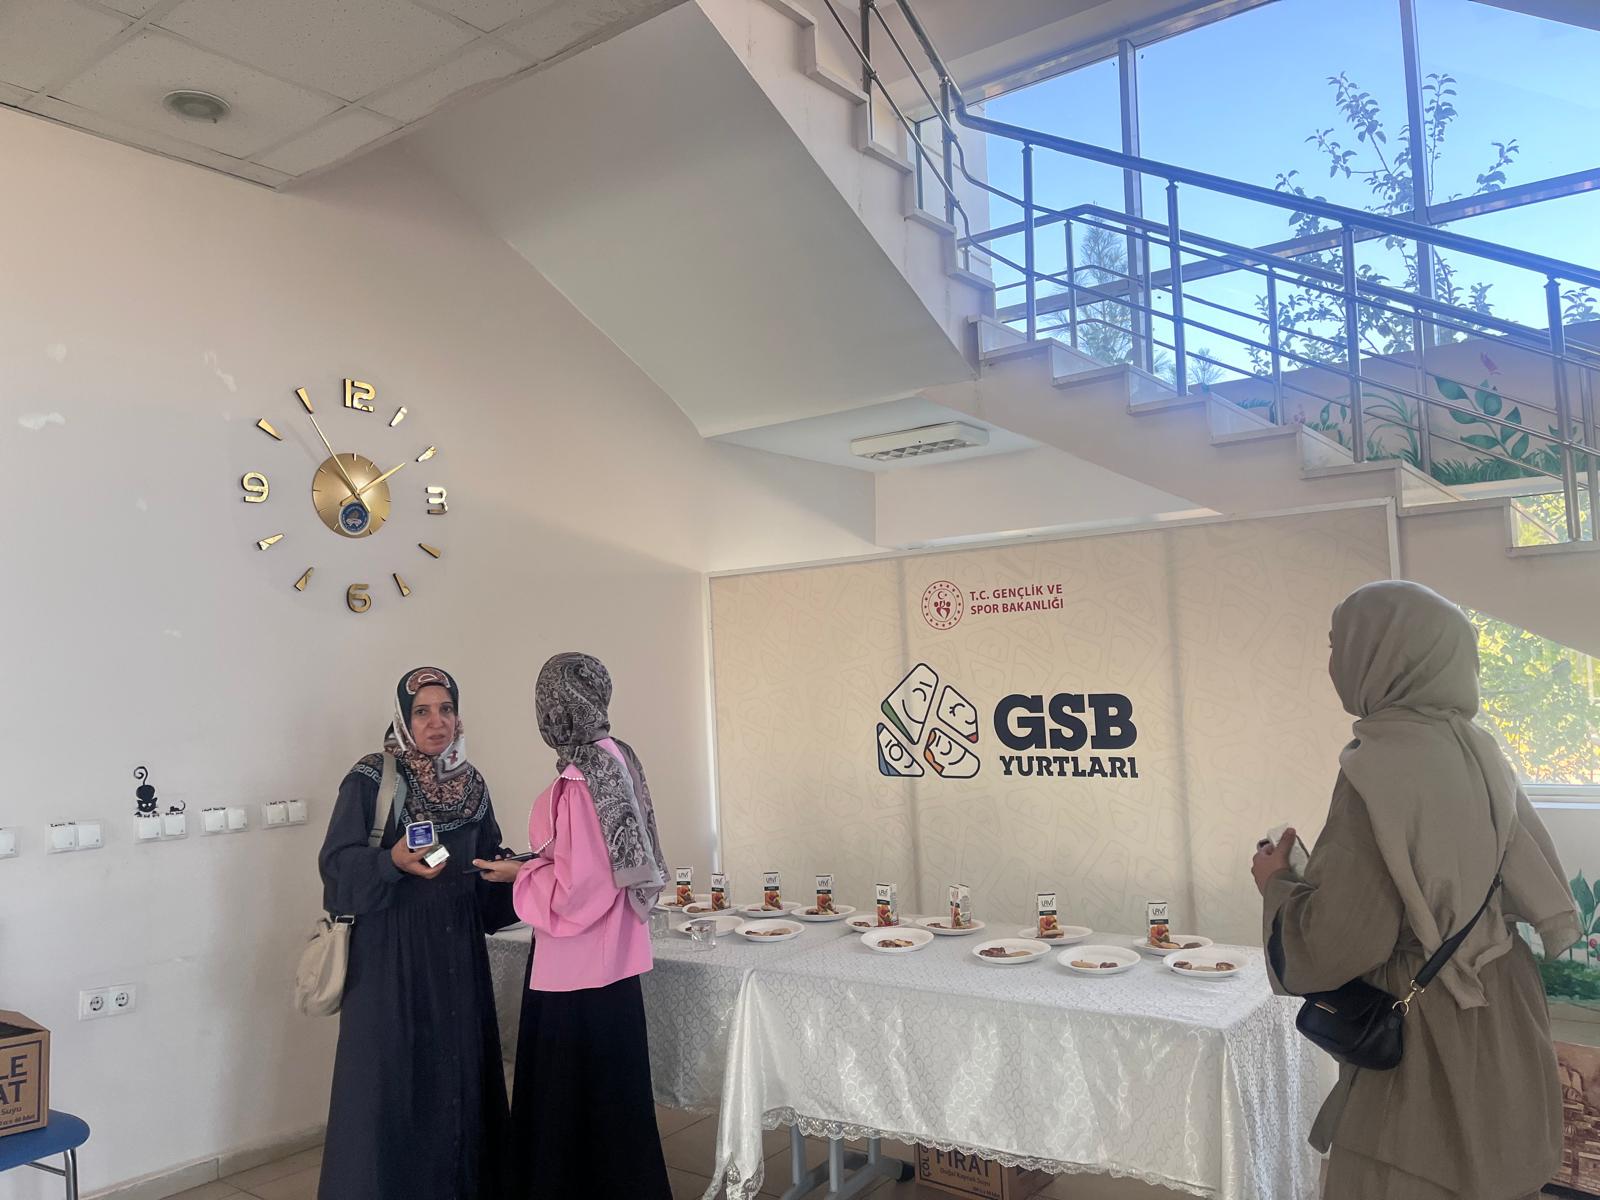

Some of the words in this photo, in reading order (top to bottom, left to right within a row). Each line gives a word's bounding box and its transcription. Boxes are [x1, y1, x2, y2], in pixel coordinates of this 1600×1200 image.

[343, 378, 376, 413] 12
[241, 471, 270, 504] 9
[425, 486, 448, 515] 3
[347, 583, 372, 613] 6
[970, 590, 990, 601] T.C.
[993, 584, 1043, 599] GENÇLİK
[1047, 584, 1063, 595] VE
[970, 604, 999, 615] SPOR
[1002, 597, 1064, 613] BAKANLIĞI
[993, 692, 1138, 752] GSB
[999, 755, 1139, 779] YURTLARI
